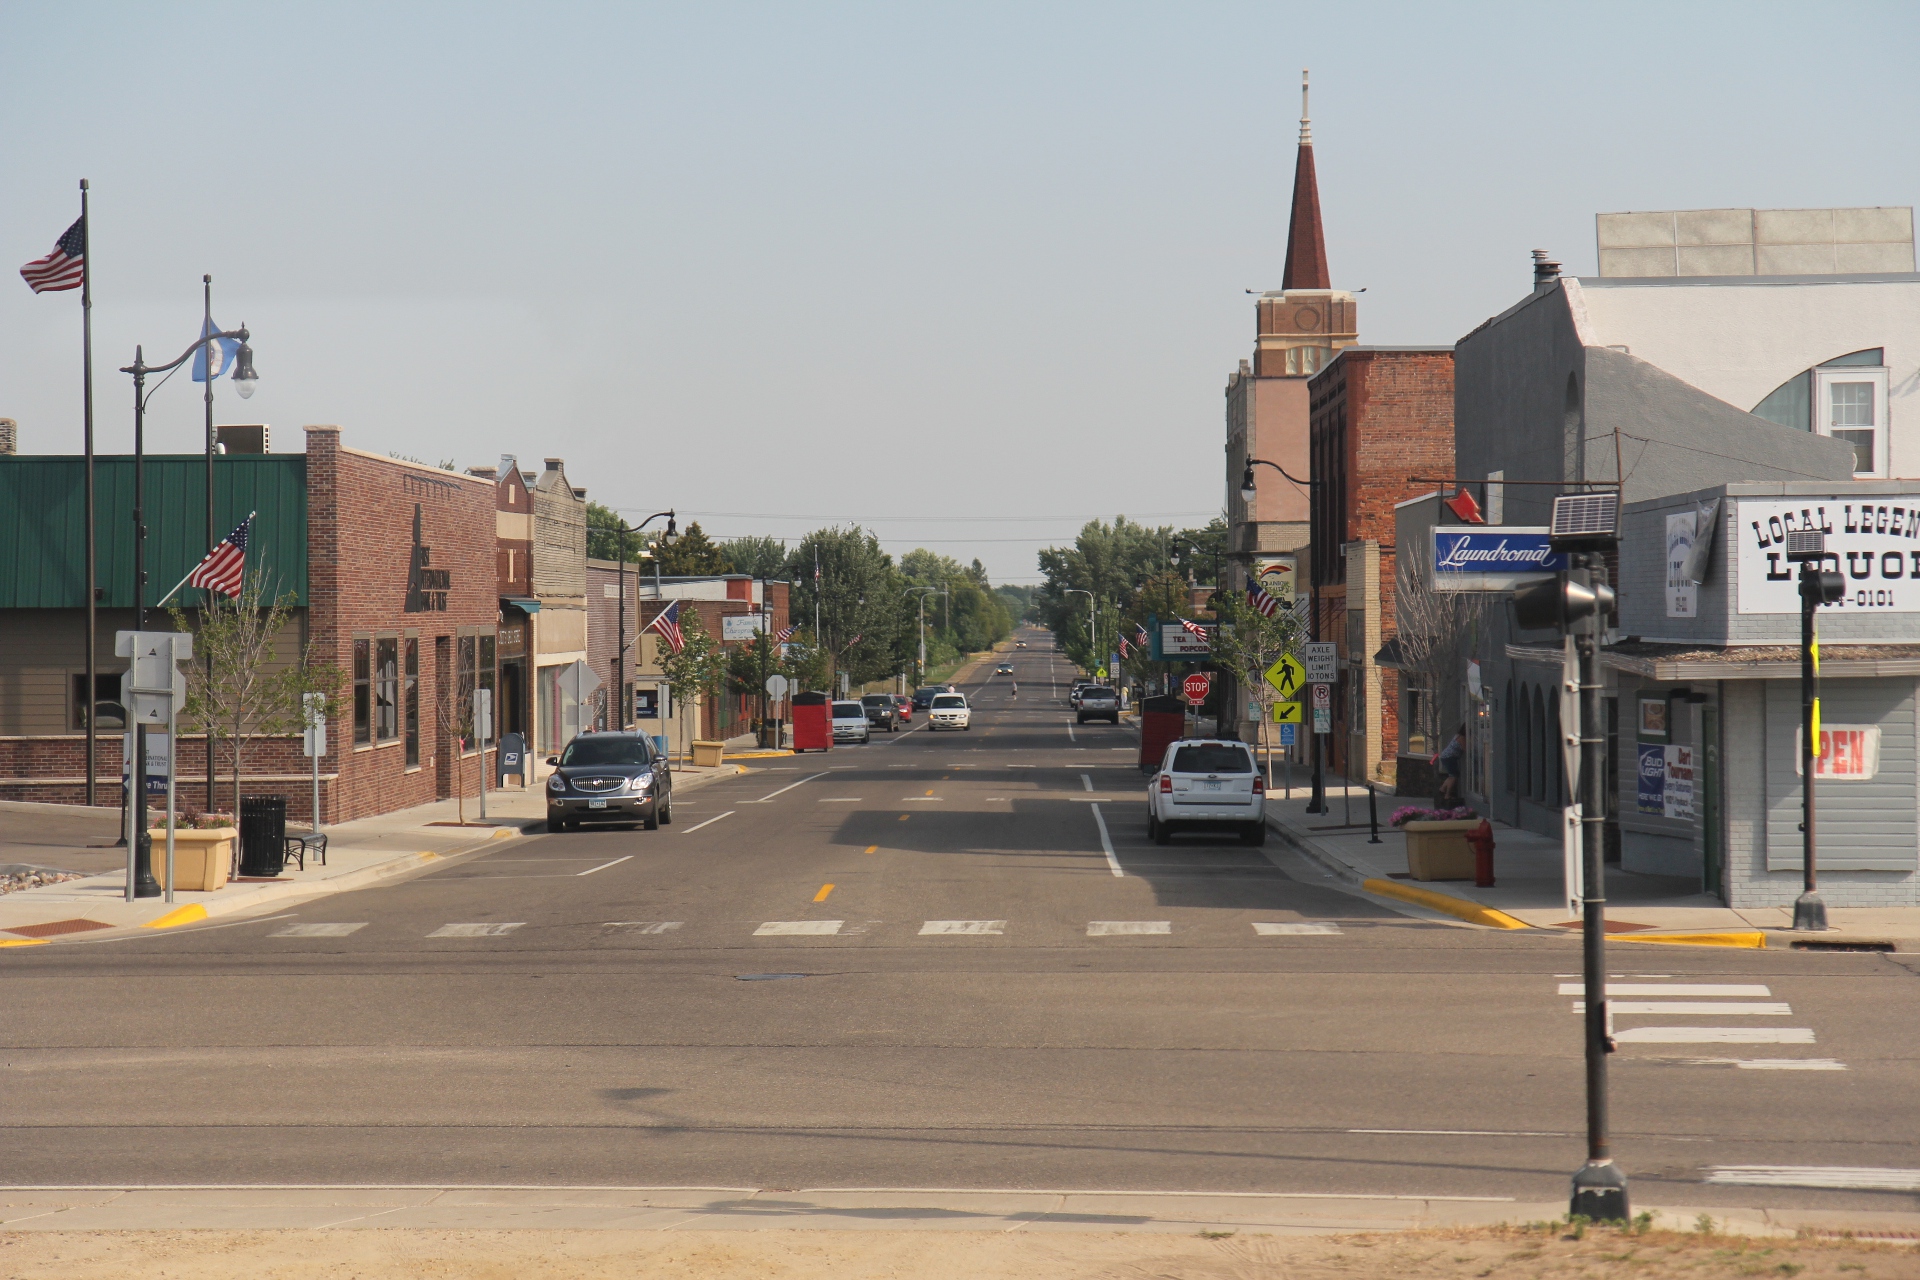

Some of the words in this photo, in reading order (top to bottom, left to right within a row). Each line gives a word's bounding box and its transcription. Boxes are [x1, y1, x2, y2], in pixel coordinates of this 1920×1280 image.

[1752, 506, 1833, 549] LOCAL
[1438, 536, 1556, 567] Laundromat
[1316, 672, 1335, 680] TONS
[1185, 682, 1208, 692] STOP
[1814, 731, 1864, 774] PEN
[1645, 756, 1663, 767] BUD
[1641, 766, 1664, 778] LIGHT
